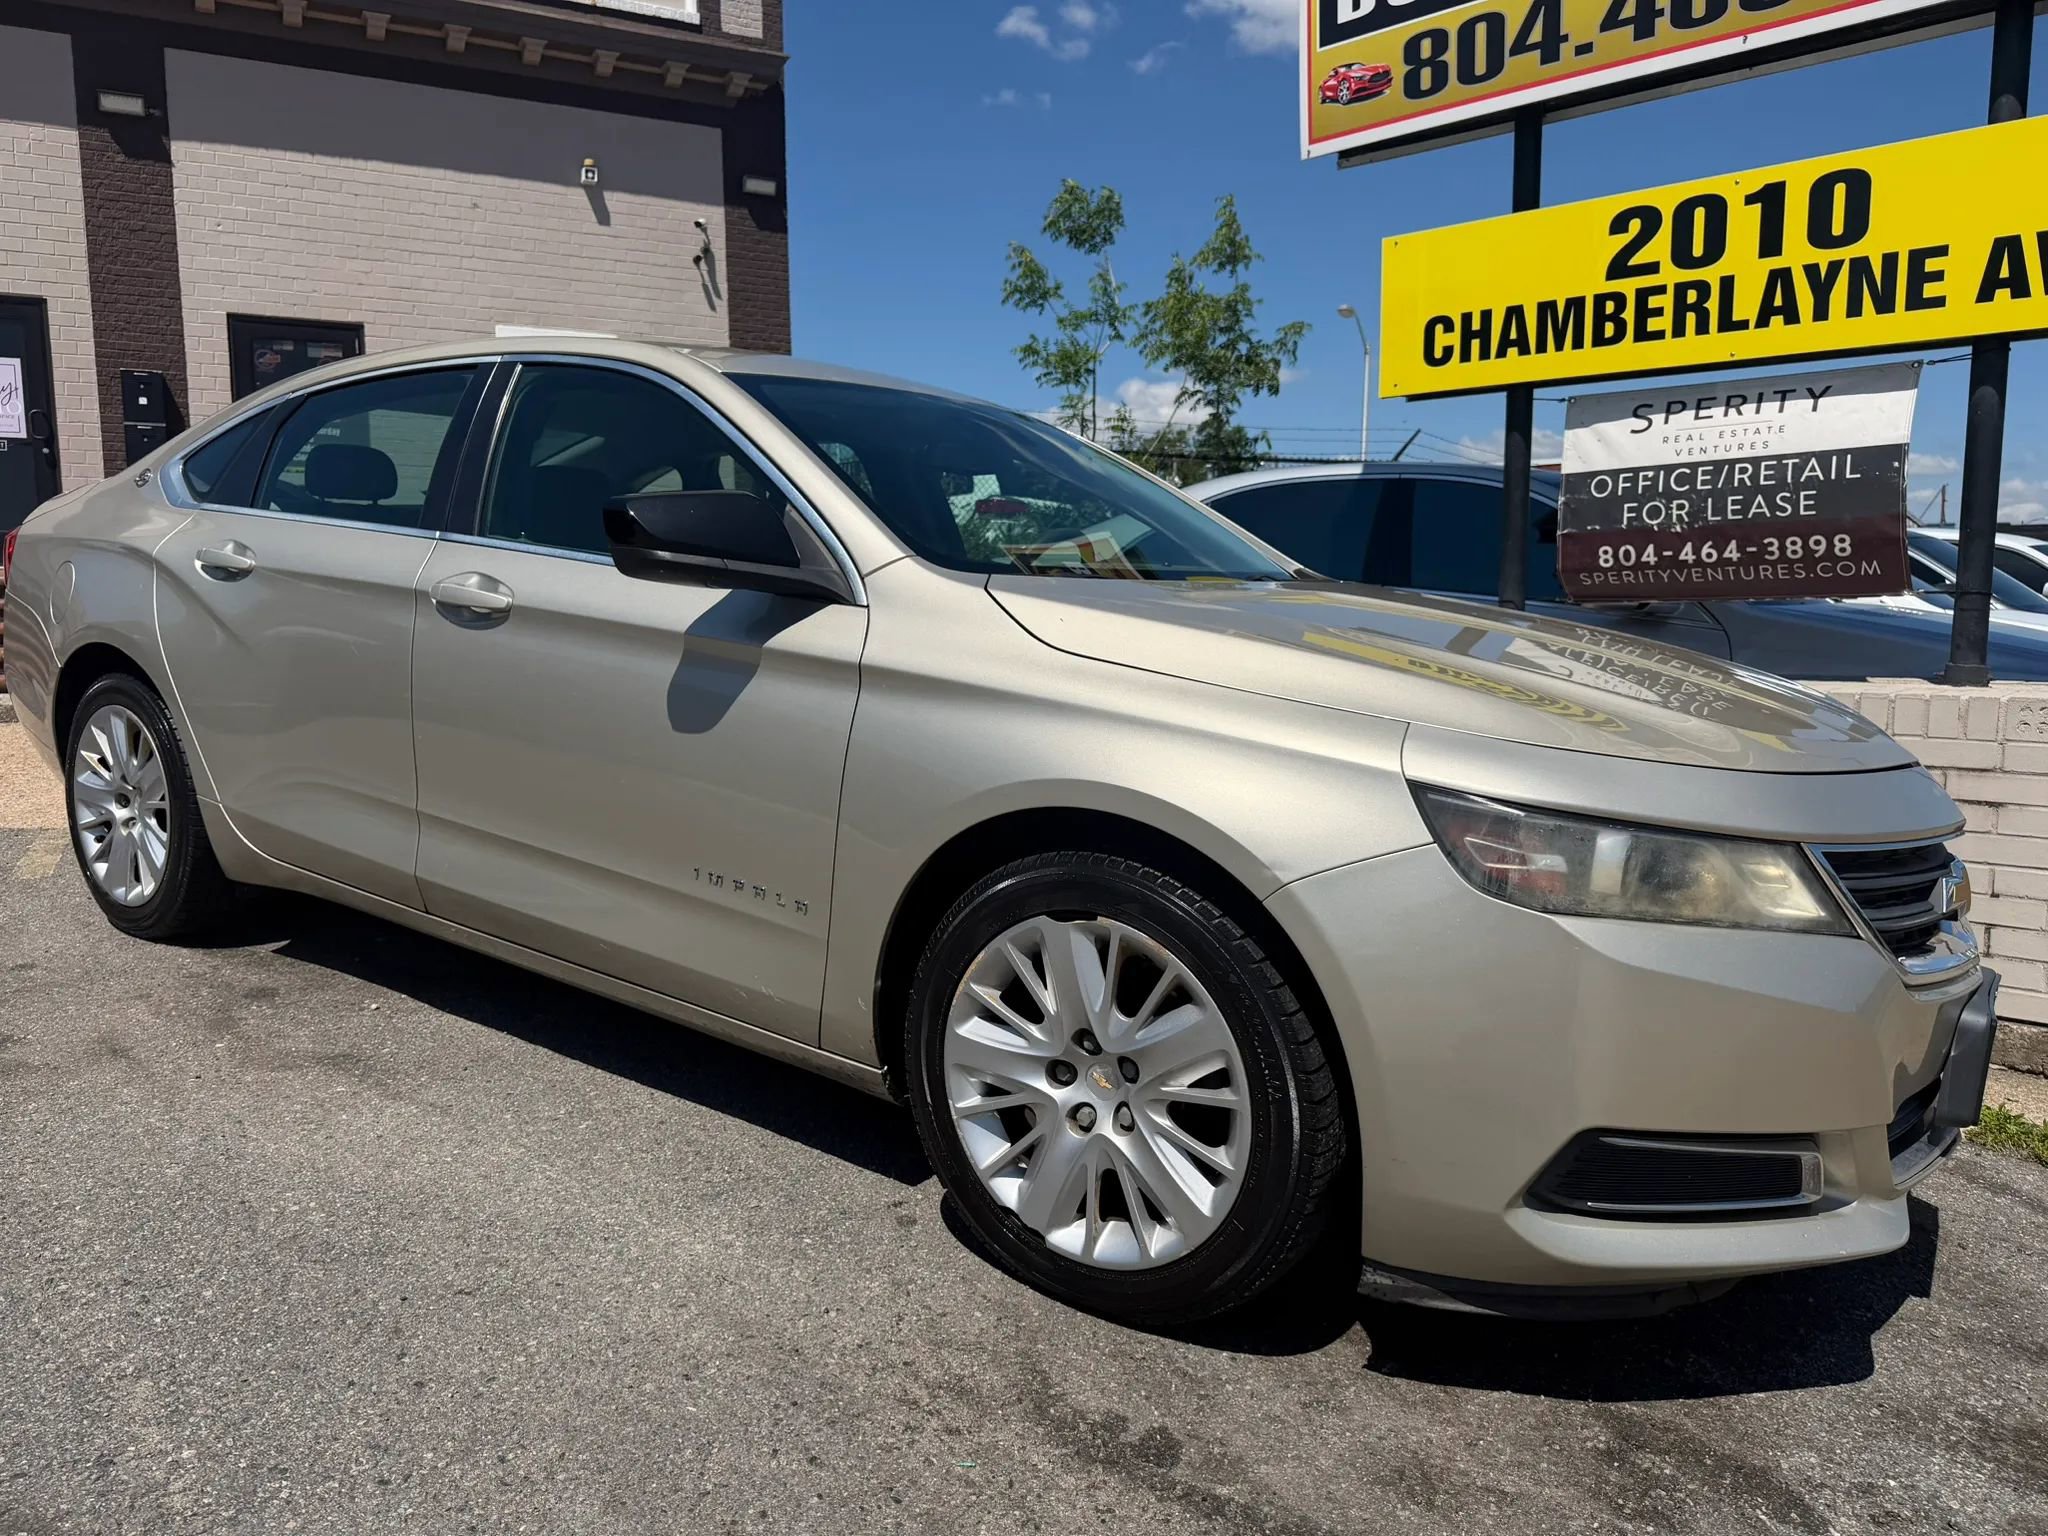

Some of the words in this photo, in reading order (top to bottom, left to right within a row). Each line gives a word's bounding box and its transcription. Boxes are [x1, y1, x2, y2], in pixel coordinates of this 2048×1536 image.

[1402, 0, 1792, 101] 804.4
[1605, 168, 1873, 281] 2010
[1422, 244, 1950, 368] CHAMBERLAYNE
[1974, 230, 2048, 304] A
[1629, 385, 1833, 434] SPERITY
[1662, 433, 1706, 445] REAL
[1718, 424, 1787, 440] ESTATE
[1674, 440, 1770, 457] VENTURES
[1590, 454, 1862, 498] OFFICE/RETAIL
[1622, 499, 1690, 526] FOR
[1706, 490, 1818, 522] LEASE
[1598, 533, 1853, 569] 804-464-3898
[1579, 559, 1882, 586] SPERITYVENTURES.COM
